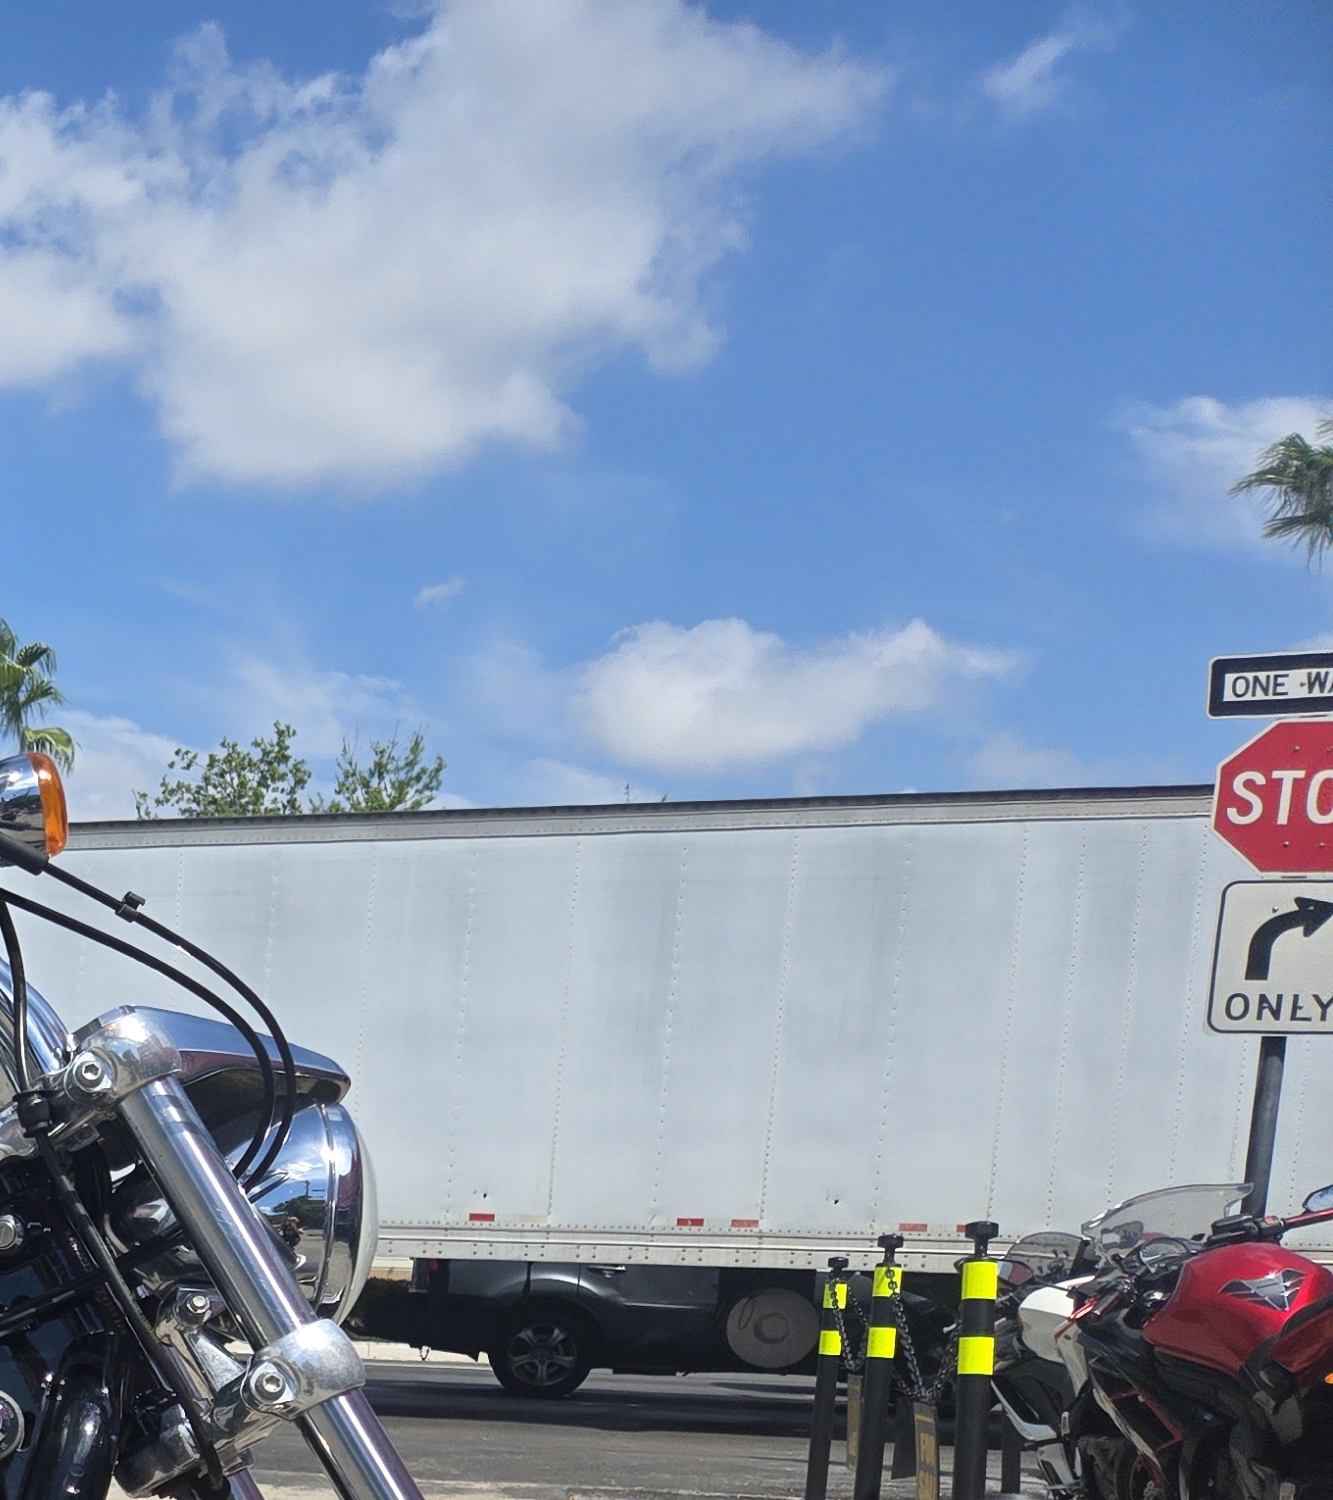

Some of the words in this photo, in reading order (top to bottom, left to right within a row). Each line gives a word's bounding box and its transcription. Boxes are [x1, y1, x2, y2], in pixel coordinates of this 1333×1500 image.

[1231, 673, 1290, 698] ONE
[1306, 670, 1333, 695] W
[1224, 993, 1333, 1023] ONLY
